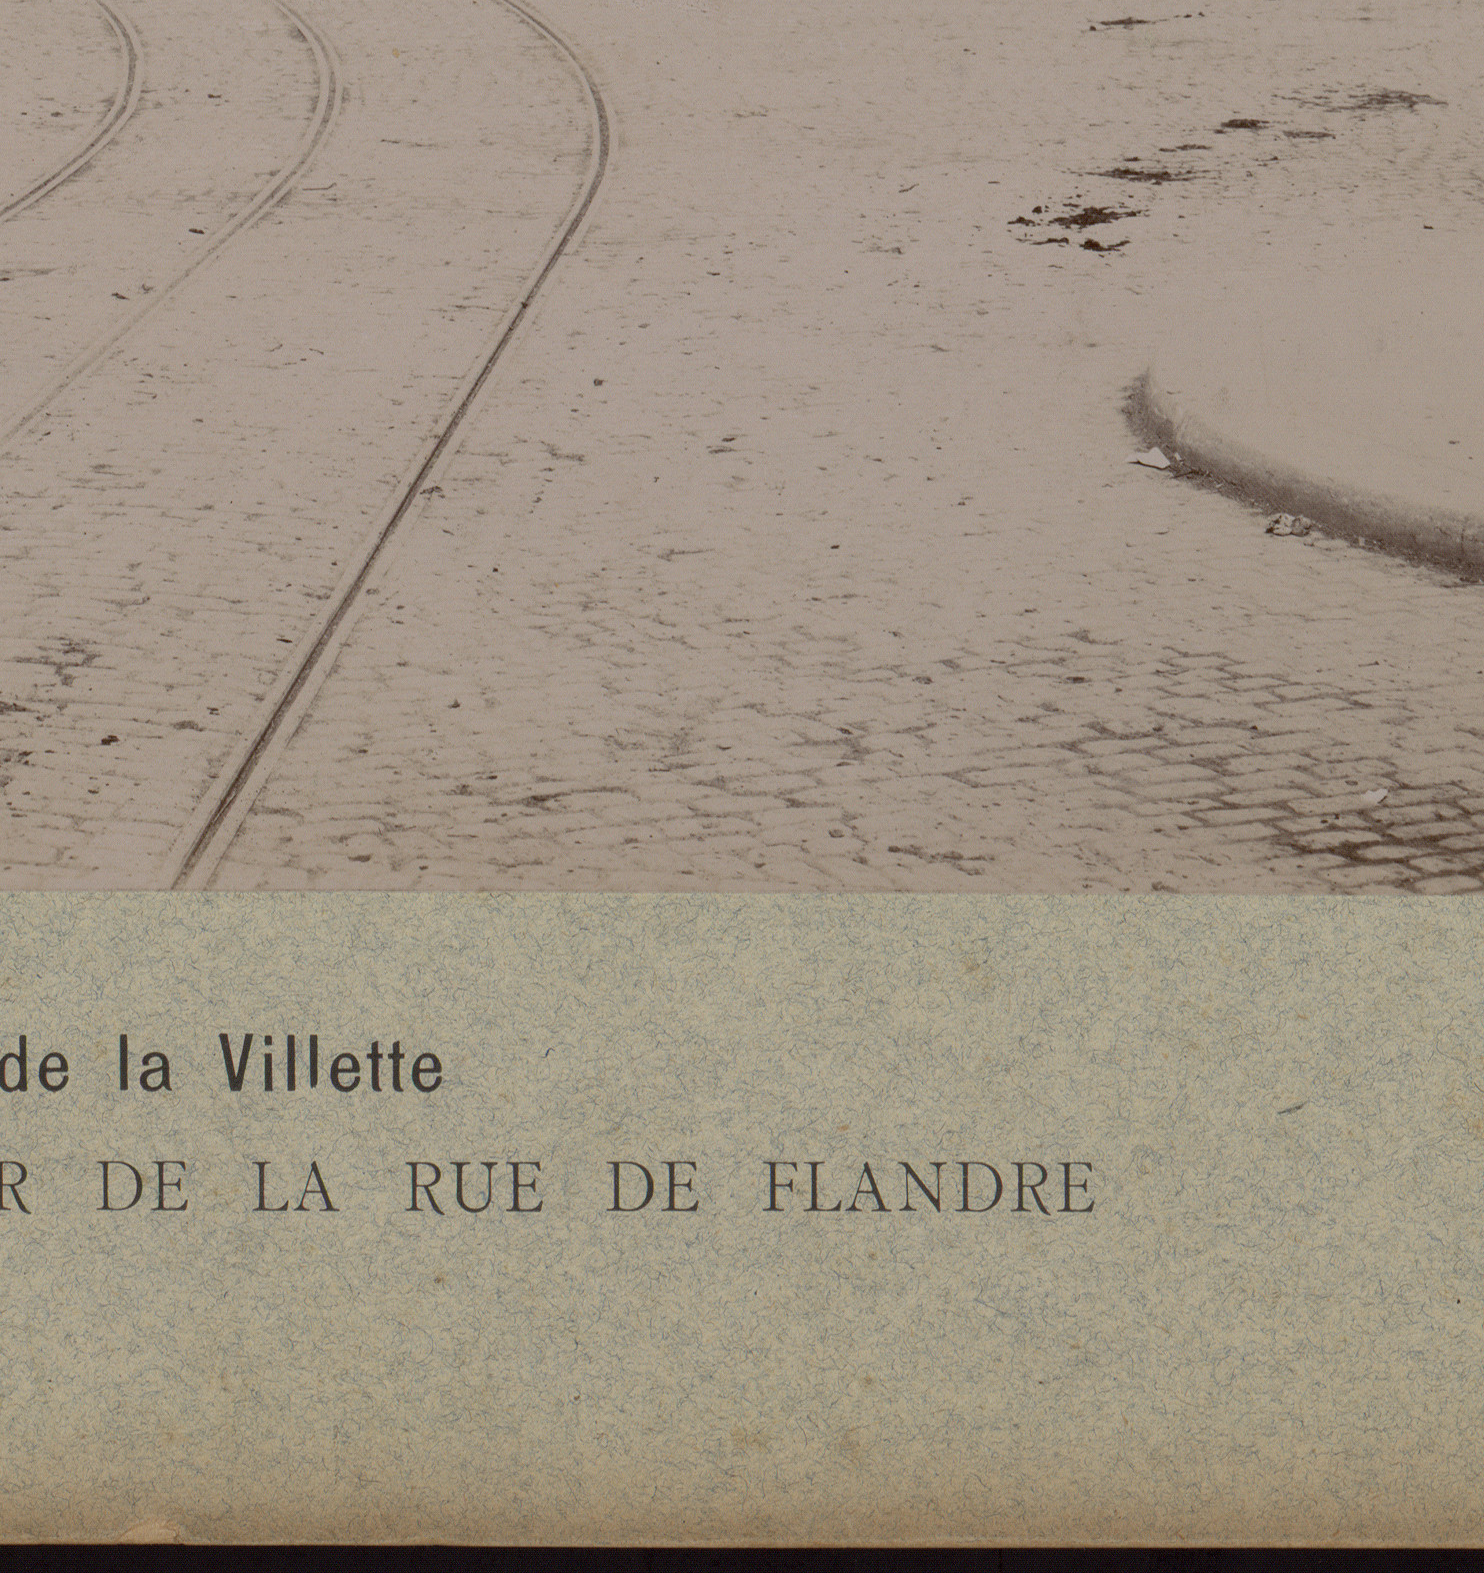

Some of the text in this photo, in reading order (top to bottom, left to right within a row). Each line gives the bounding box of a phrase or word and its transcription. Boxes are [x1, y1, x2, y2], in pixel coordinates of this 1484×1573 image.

[118, 1033, 173, 1093] la
[218, 1032, 444, 1093] Villette
[99, 1159, 188, 1212] DE
[254, 1160, 337, 1213] LA
[407, 1160, 544, 1216] RUE
[610, 1160, 700, 1213] DE
[766, 1160, 1095, 1216] FLANDRE
